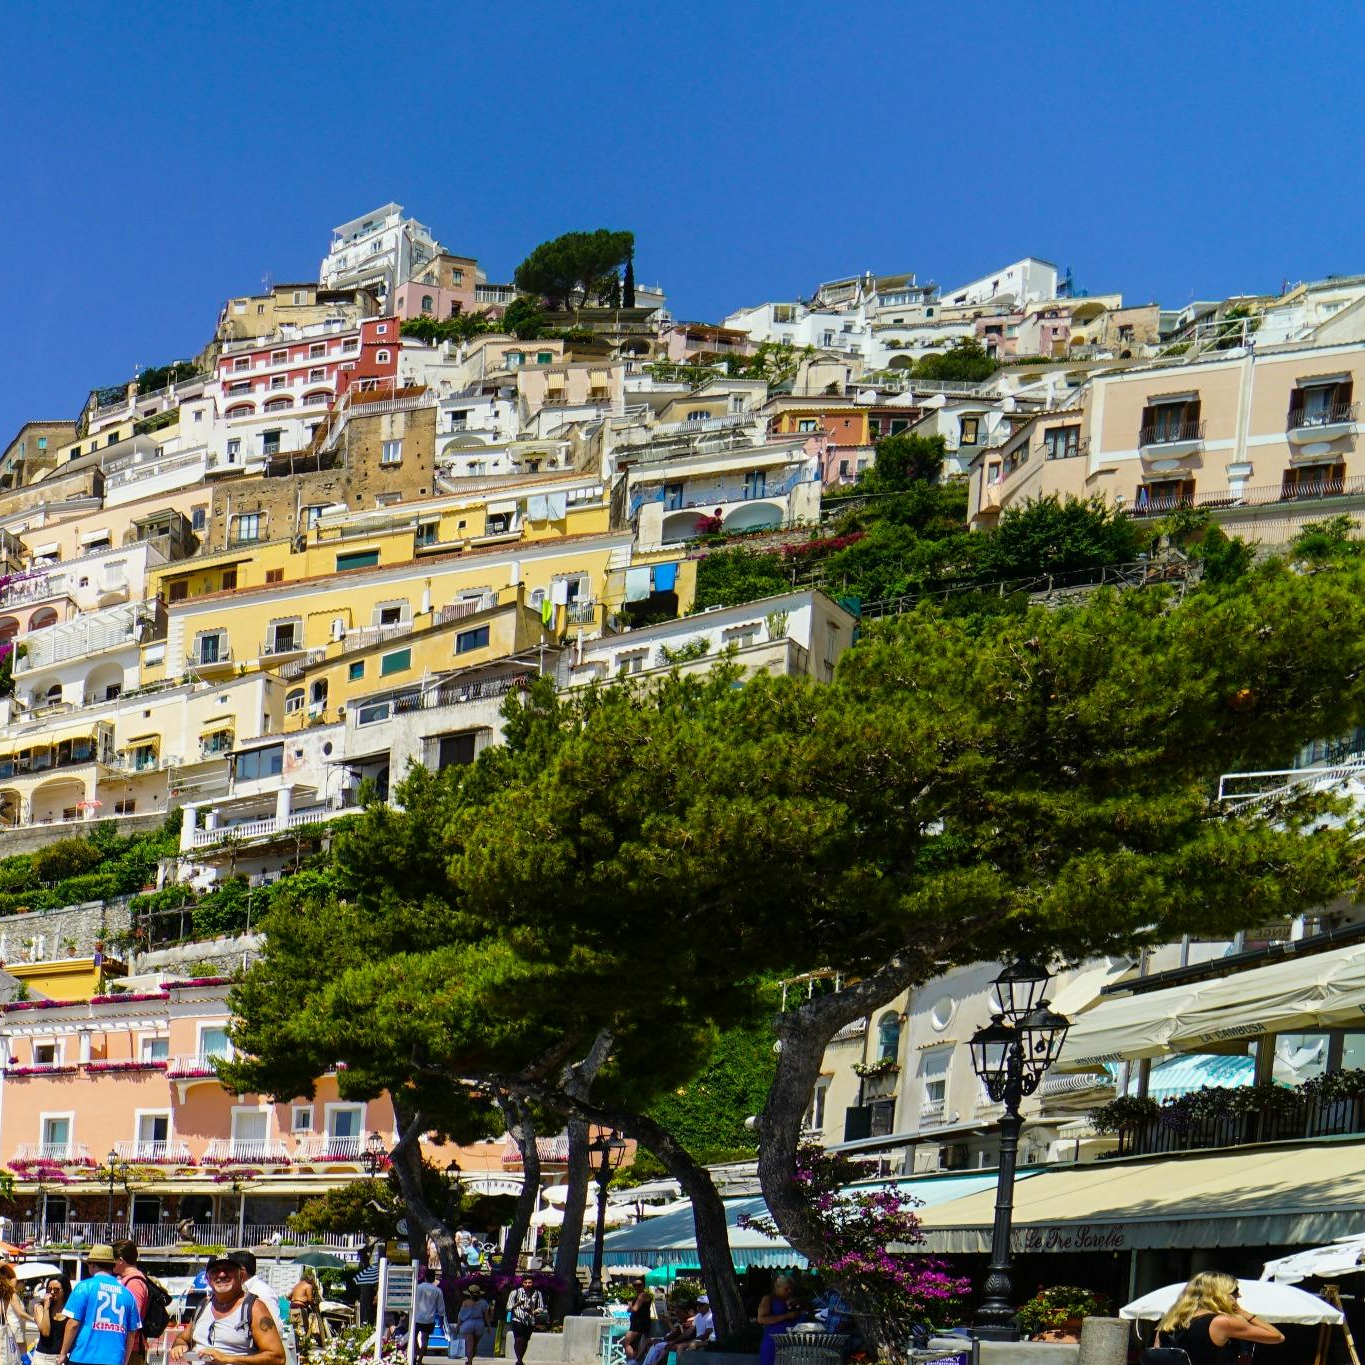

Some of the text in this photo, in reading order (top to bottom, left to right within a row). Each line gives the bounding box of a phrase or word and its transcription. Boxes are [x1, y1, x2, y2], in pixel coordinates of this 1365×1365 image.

[1199, 1033, 1213, 1042] LA
[1215, 1022, 1267, 1039] CAMBUSA
[1025, 1224, 1125, 1248] Le Tre Sorelle
[96, 1290, 125, 1326] 24
[93, 1322, 125, 1332] KIMBO
